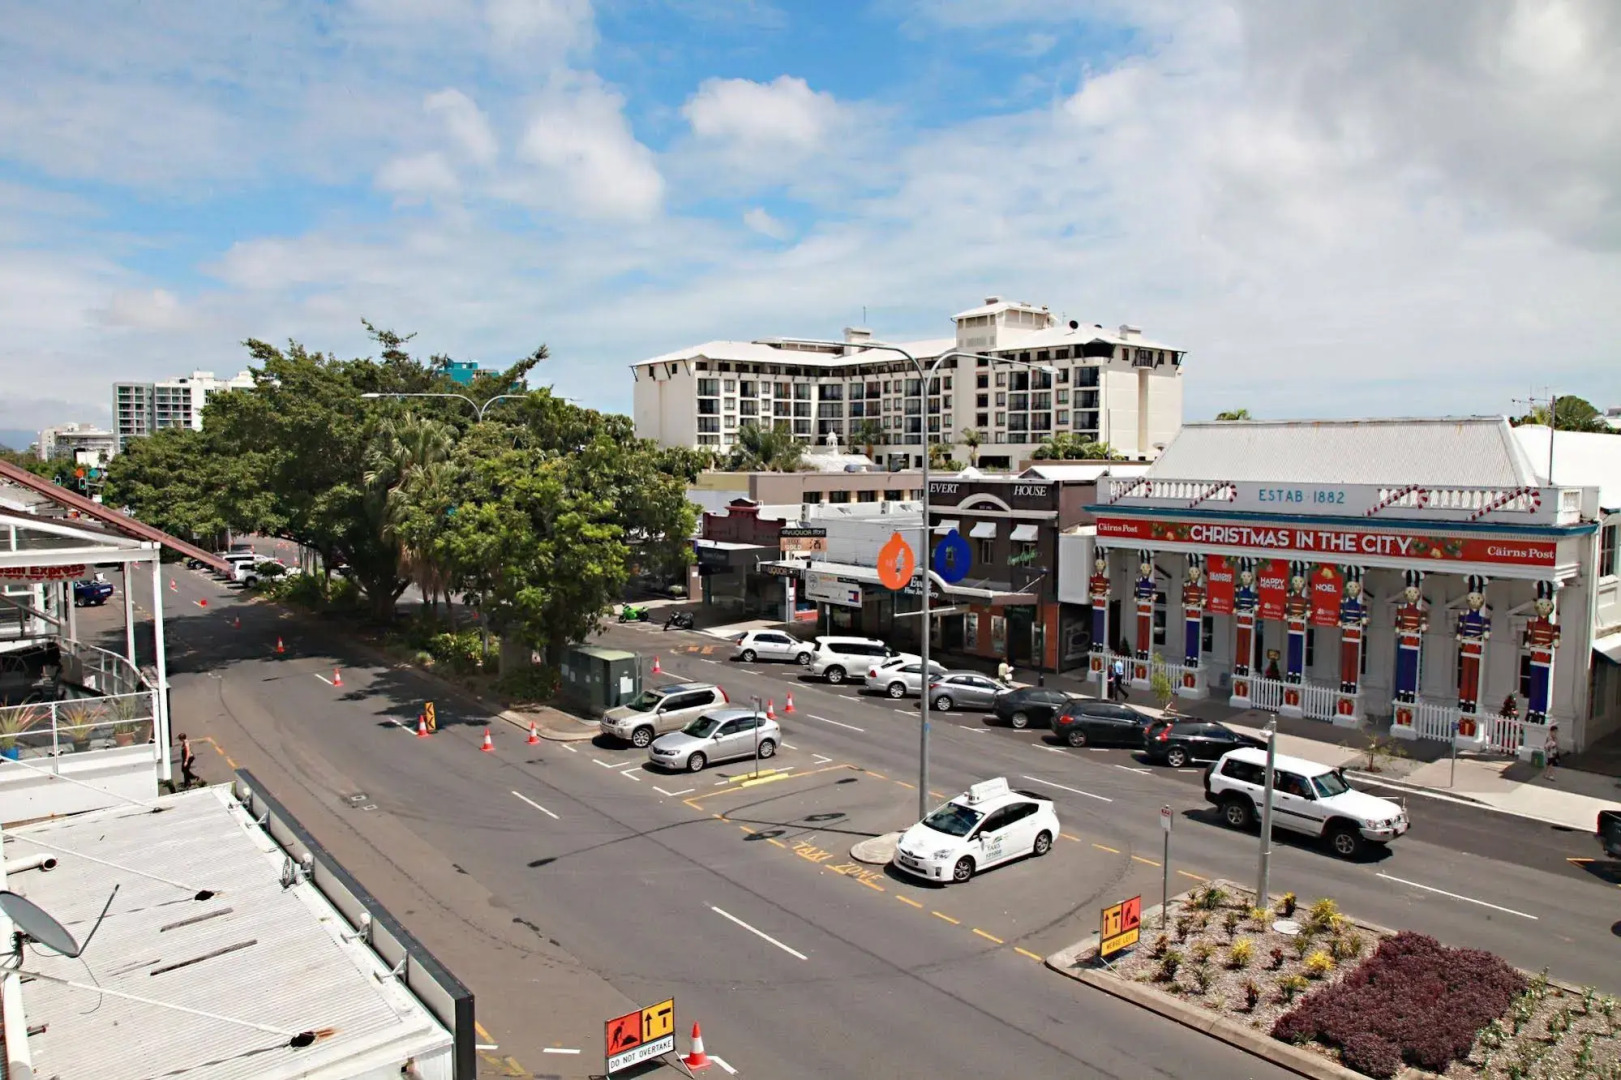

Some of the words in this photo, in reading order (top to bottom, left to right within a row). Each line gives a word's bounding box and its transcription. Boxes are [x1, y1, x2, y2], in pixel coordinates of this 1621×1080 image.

[930, 483, 959, 494] EVERT
[1014, 486, 1047, 496] HOUSE
[1259, 489, 1303, 502] ESTAB
[1314, 491, 1345, 504] 1882
[1098, 522, 1122, 532] Cairns
[1122, 524, 1138, 533] Post
[1190, 525, 1290, 549] CHRISTMAS
[1296, 531, 1314, 549] IN
[1319, 532, 1358, 551] THE
[1361, 535, 1413, 555] CITY
[1487, 545, 1526, 558] Cairns
[1529, 548, 1554, 559] Post
[1260, 577, 1285, 586] HAPPY
[1315, 583, 1337, 593] NOEL
[610, 1059, 620, 1069] DO
[622, 1054, 636, 1064] NOT
[639, 1040, 672, 1058] OVERTAKE
